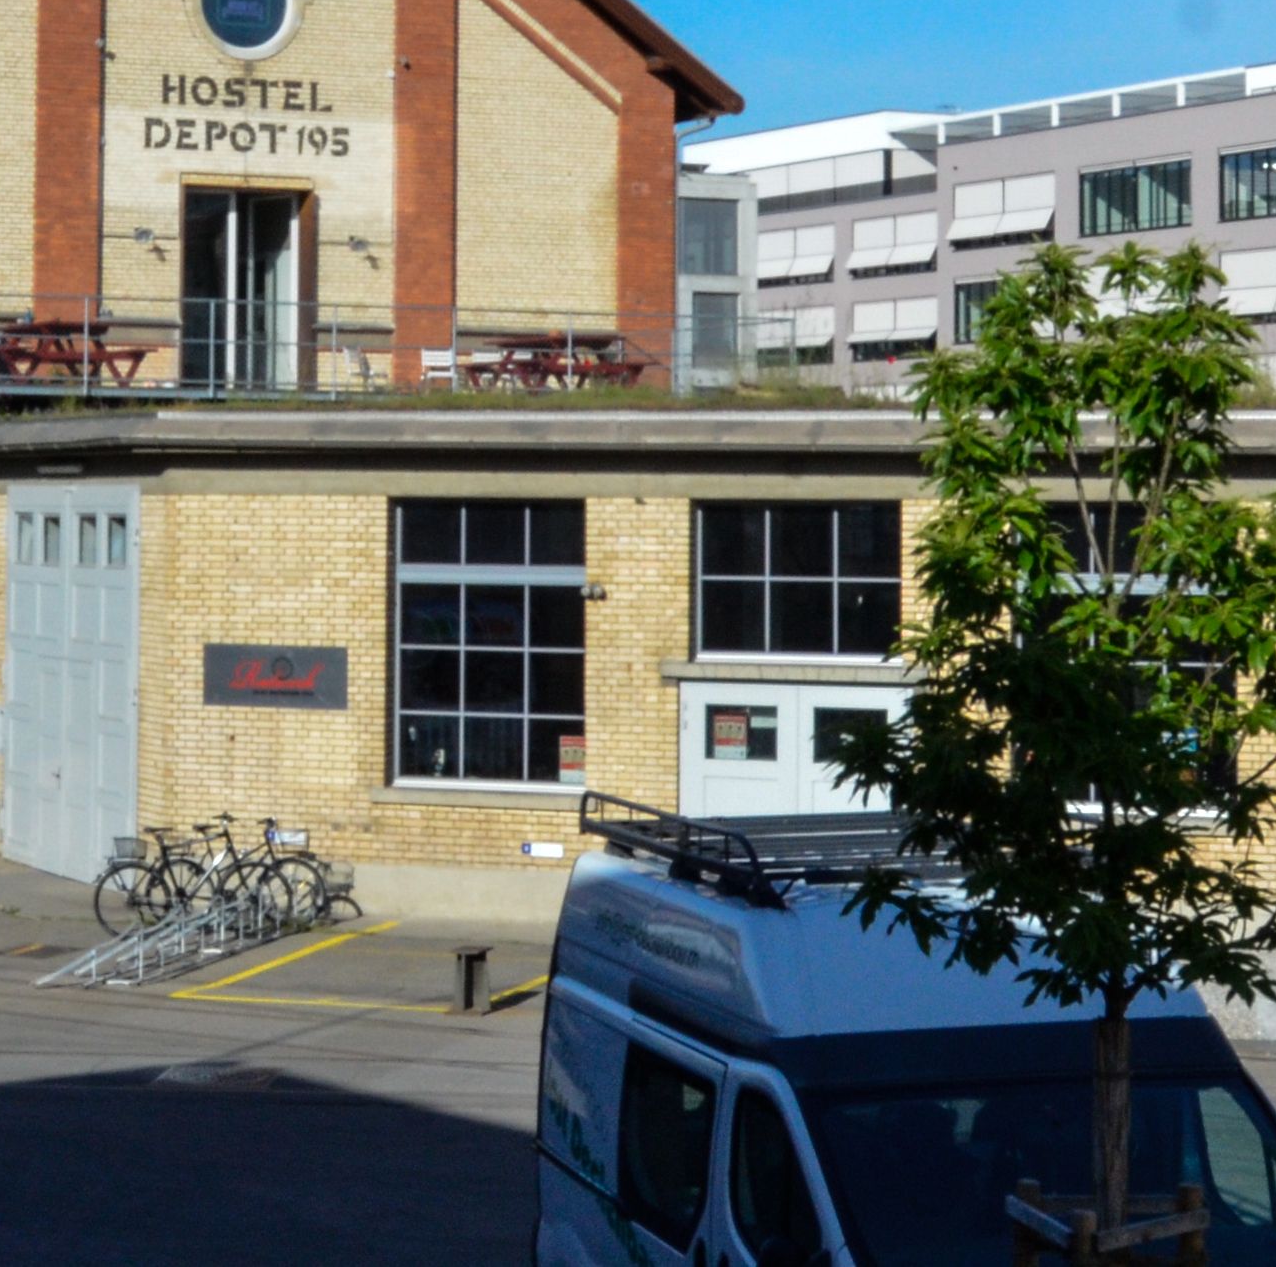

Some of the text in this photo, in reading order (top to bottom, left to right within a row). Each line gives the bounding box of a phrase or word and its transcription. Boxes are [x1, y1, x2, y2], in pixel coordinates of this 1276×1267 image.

[161, 73, 333, 113] HOSTEL
[143, 117, 350, 157] DEPOT 195
